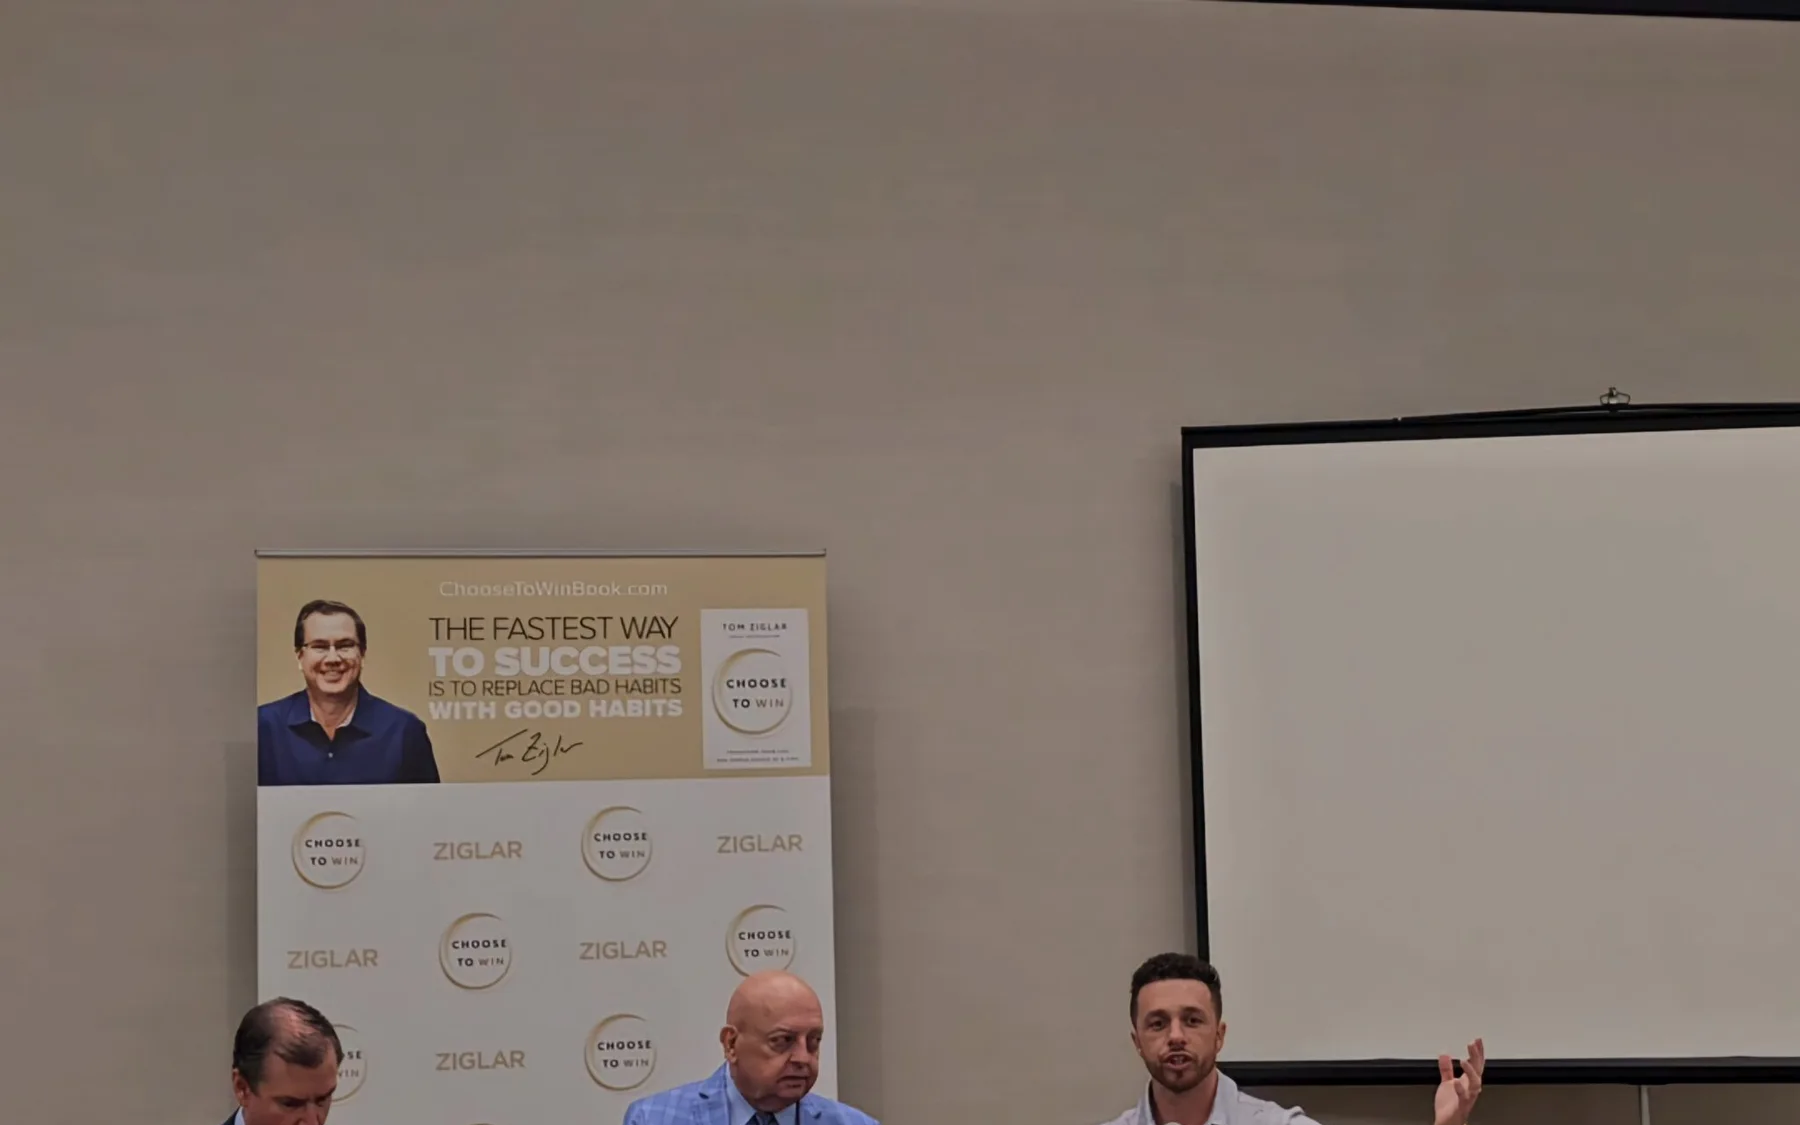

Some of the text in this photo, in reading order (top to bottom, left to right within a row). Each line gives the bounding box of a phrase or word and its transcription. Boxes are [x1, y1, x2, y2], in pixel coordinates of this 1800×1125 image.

[439, 581, 668, 597] ChooseToWinBook.com
[428, 616, 679, 641] THE FASTEST WAY
[429, 645, 682, 677] TO SUCCESS
[428, 677, 682, 697] IS TO REPLACE BAD HABITS
[726, 679, 788, 689] CHOOSE
[732, 699, 784, 709] TO WIN
[429, 699, 683, 720] WITH GOOD HABITS
[594, 832, 649, 842] CHOOSE
[305, 838, 361, 848] CHOOSE
[717, 834, 803, 854] ZIGLAR
[433, 841, 523, 861] ZIGLAR
[599, 850, 646, 859] TO WIN
[310, 857, 358, 866] TO WIN
[738, 930, 792, 940] CHOOSE
[452, 939, 507, 949] CHOOSE
[579, 940, 668, 960] ZIGLAR
[744, 948, 789, 958] TO WIN
[287, 949, 378, 970] ZIGLAR
[457, 957, 505, 967] TO WIN
[597, 1040, 651, 1050] CHOOSE
[436, 1051, 526, 1071] ZIGLAR
[602, 1059, 649, 1068] TO WIN
